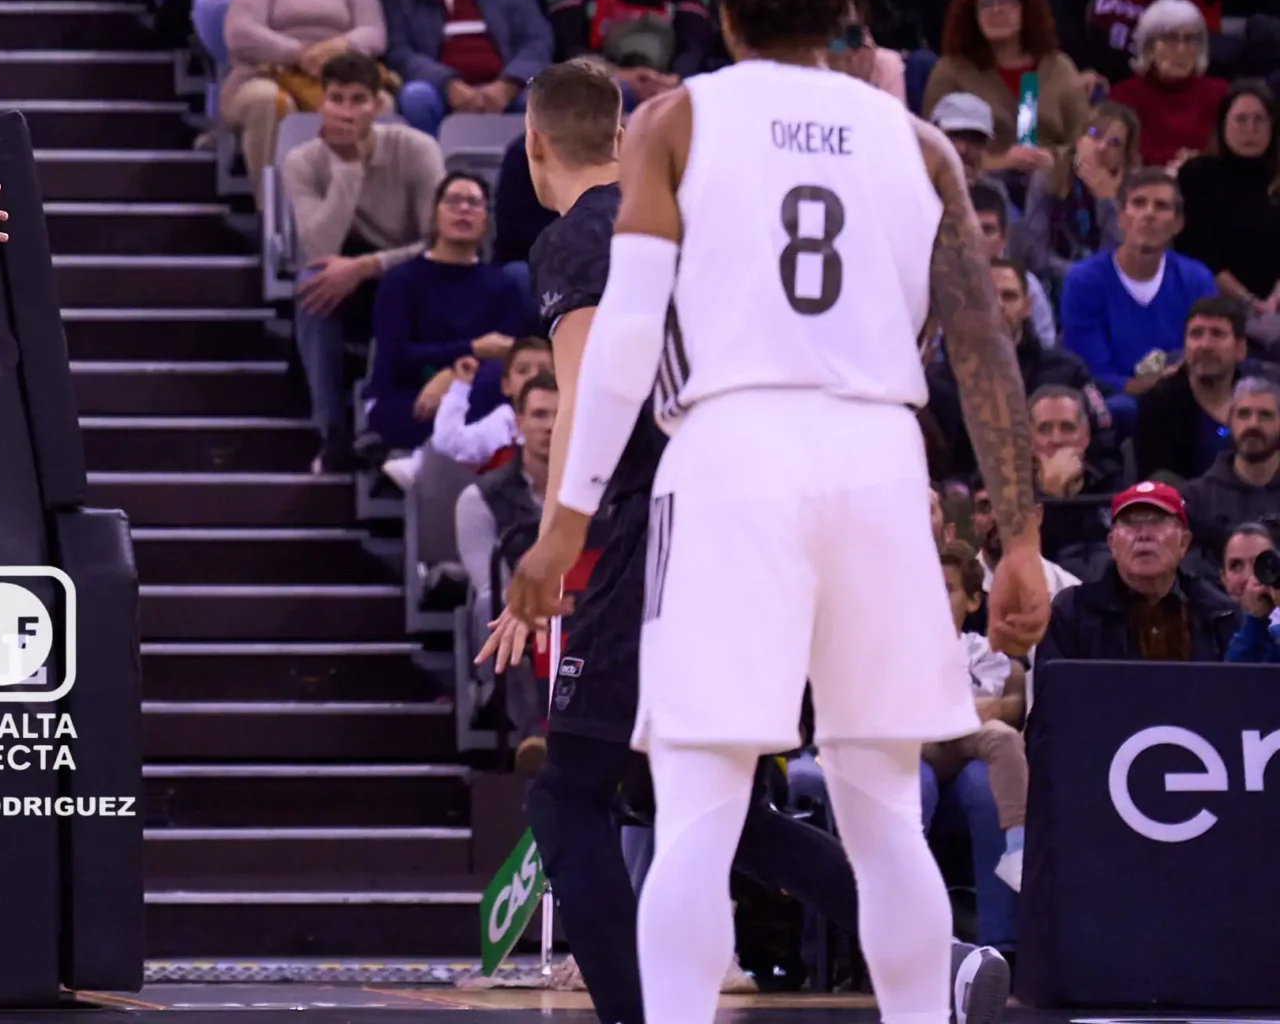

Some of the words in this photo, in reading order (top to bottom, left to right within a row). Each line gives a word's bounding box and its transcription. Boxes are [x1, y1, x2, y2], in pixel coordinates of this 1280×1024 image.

[770, 119, 853, 156] OKEKE
[779, 184, 846, 316] 8
[488, 840, 543, 944] CAS
